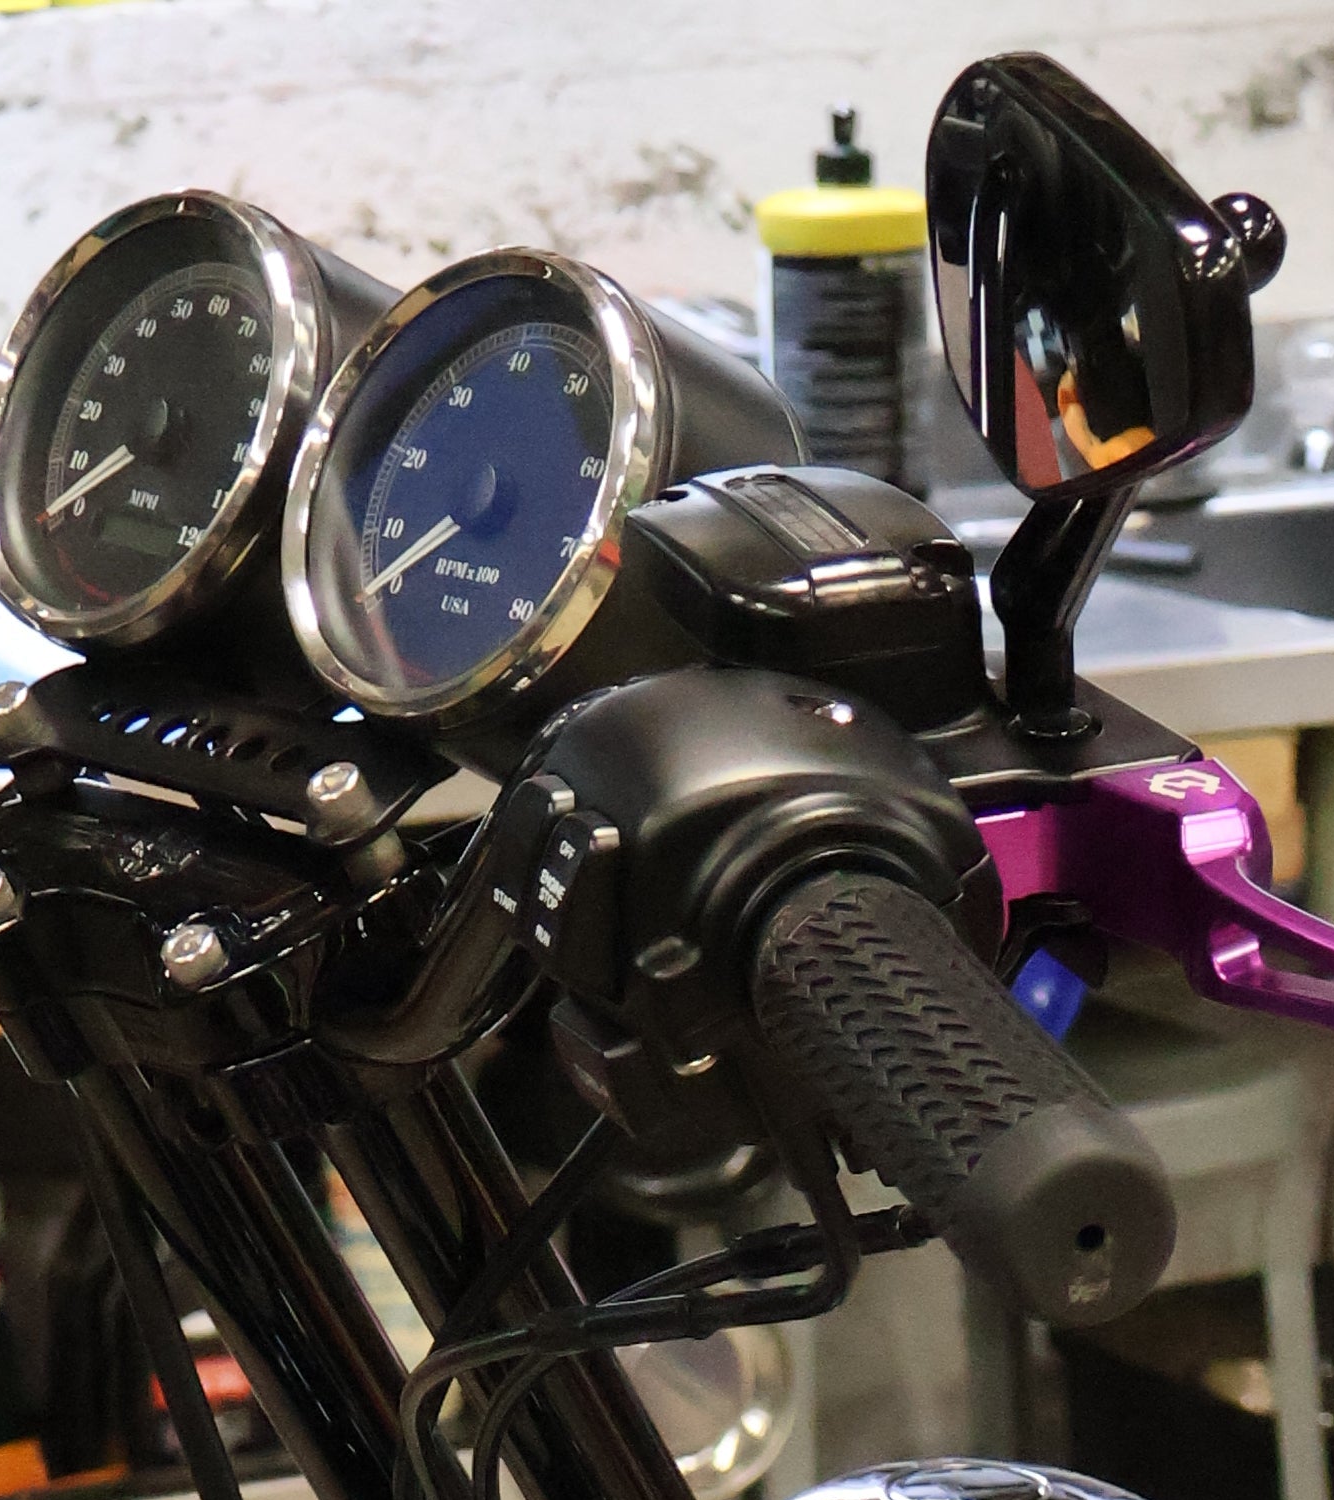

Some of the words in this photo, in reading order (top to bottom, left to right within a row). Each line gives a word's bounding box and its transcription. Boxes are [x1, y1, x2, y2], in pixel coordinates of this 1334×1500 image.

[171, 299, 193, 319] 50
[207, 294, 230, 317] 60
[135, 318, 157, 338] 40
[237, 316, 258, 338] 70
[104, 354, 125, 376] 30
[249, 353, 272, 375] 80
[507, 351, 531, 373] 40
[563, 373, 588, 396] 50
[448, 385, 472, 408] 30
[79, 401, 102, 422] 20
[69, 450, 89, 471] 10
[402, 448, 427, 470] 20
[580, 456, 605, 480] 60
[73, 497, 85, 517] 0
[128, 488, 159, 511] MPH
[382, 517, 404, 539] 10
[390, 576, 403, 595] 0
[441, 595, 469, 616] USA
[508, 598, 534, 622] 80
[493, 887, 517, 914] START
